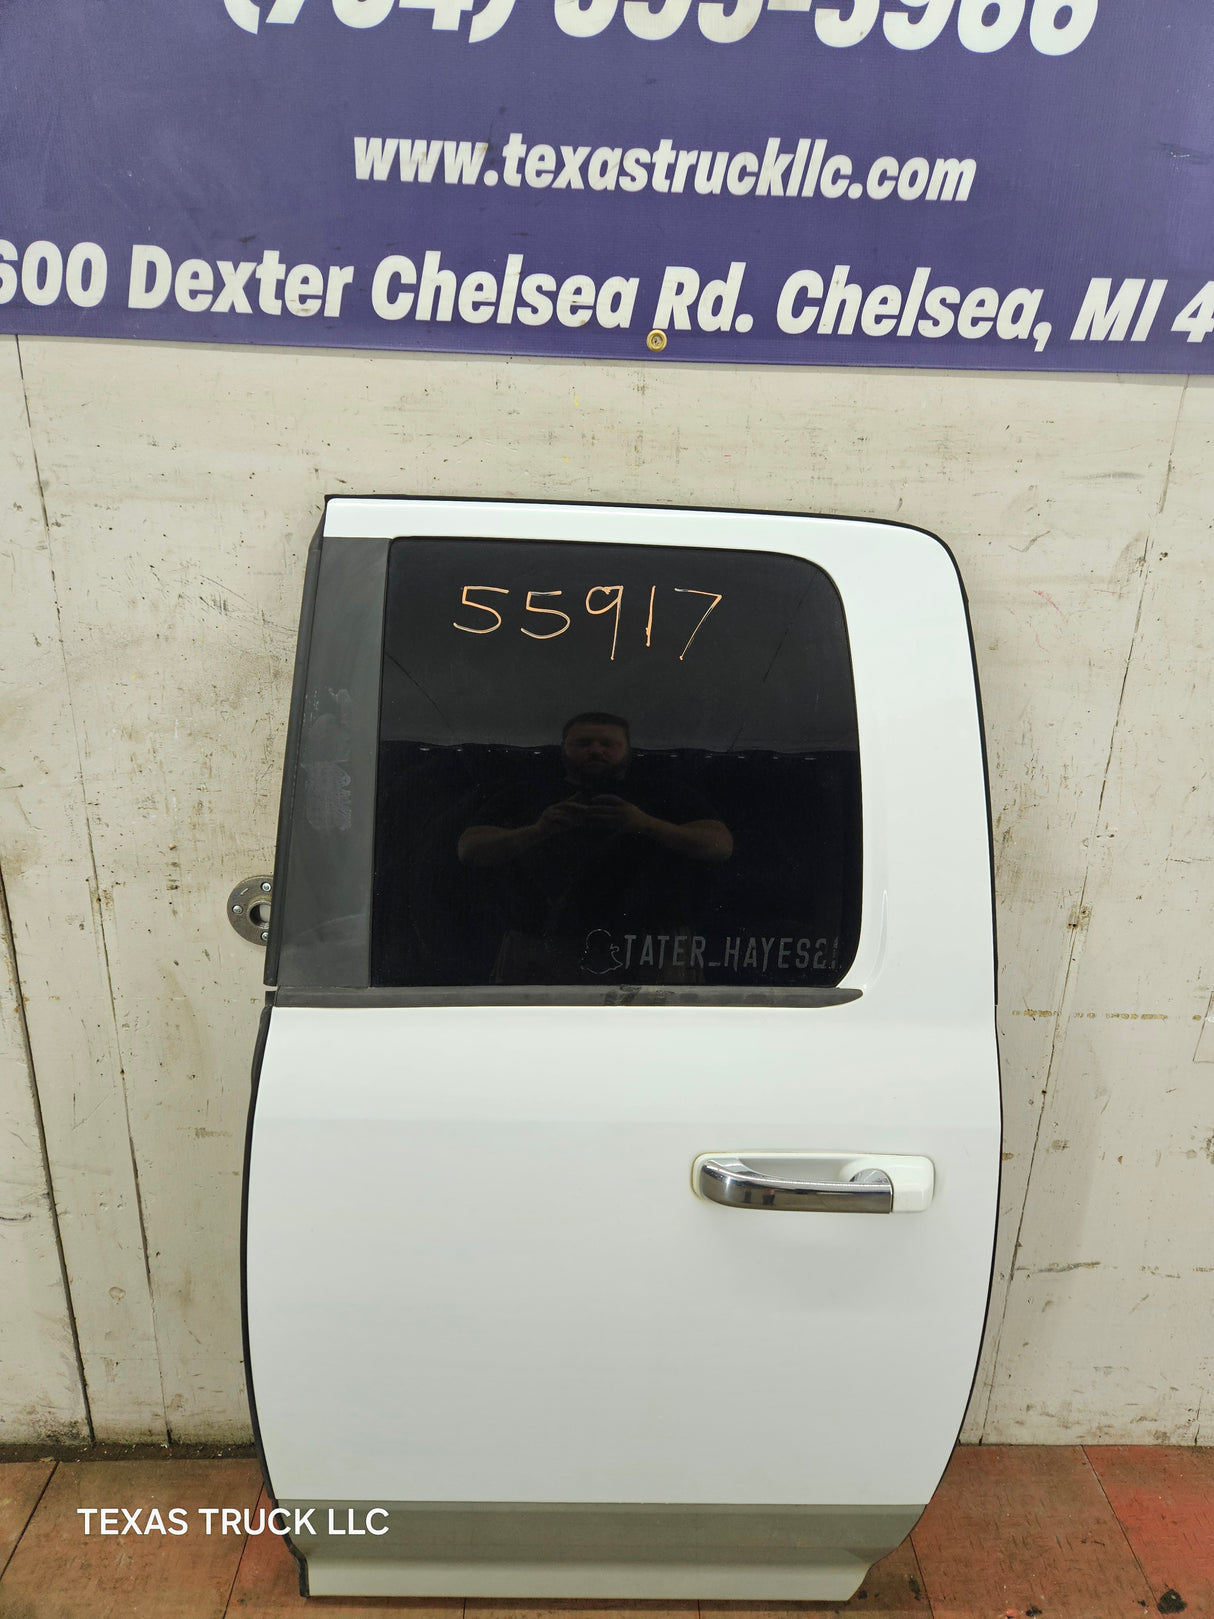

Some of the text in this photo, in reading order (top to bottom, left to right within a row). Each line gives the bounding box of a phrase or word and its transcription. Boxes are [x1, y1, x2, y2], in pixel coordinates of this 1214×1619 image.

[354, 132, 977, 202] www.texastruckllc.com
[128, 245, 355, 318] Dexter
[372, 250, 640, 329] Chelsea
[652, 262, 753, 333] Rd.
[777, 265, 1051, 352] Chelsea,
[1070, 278, 1168, 342] MI
[453, 585, 723, 661] 55917
